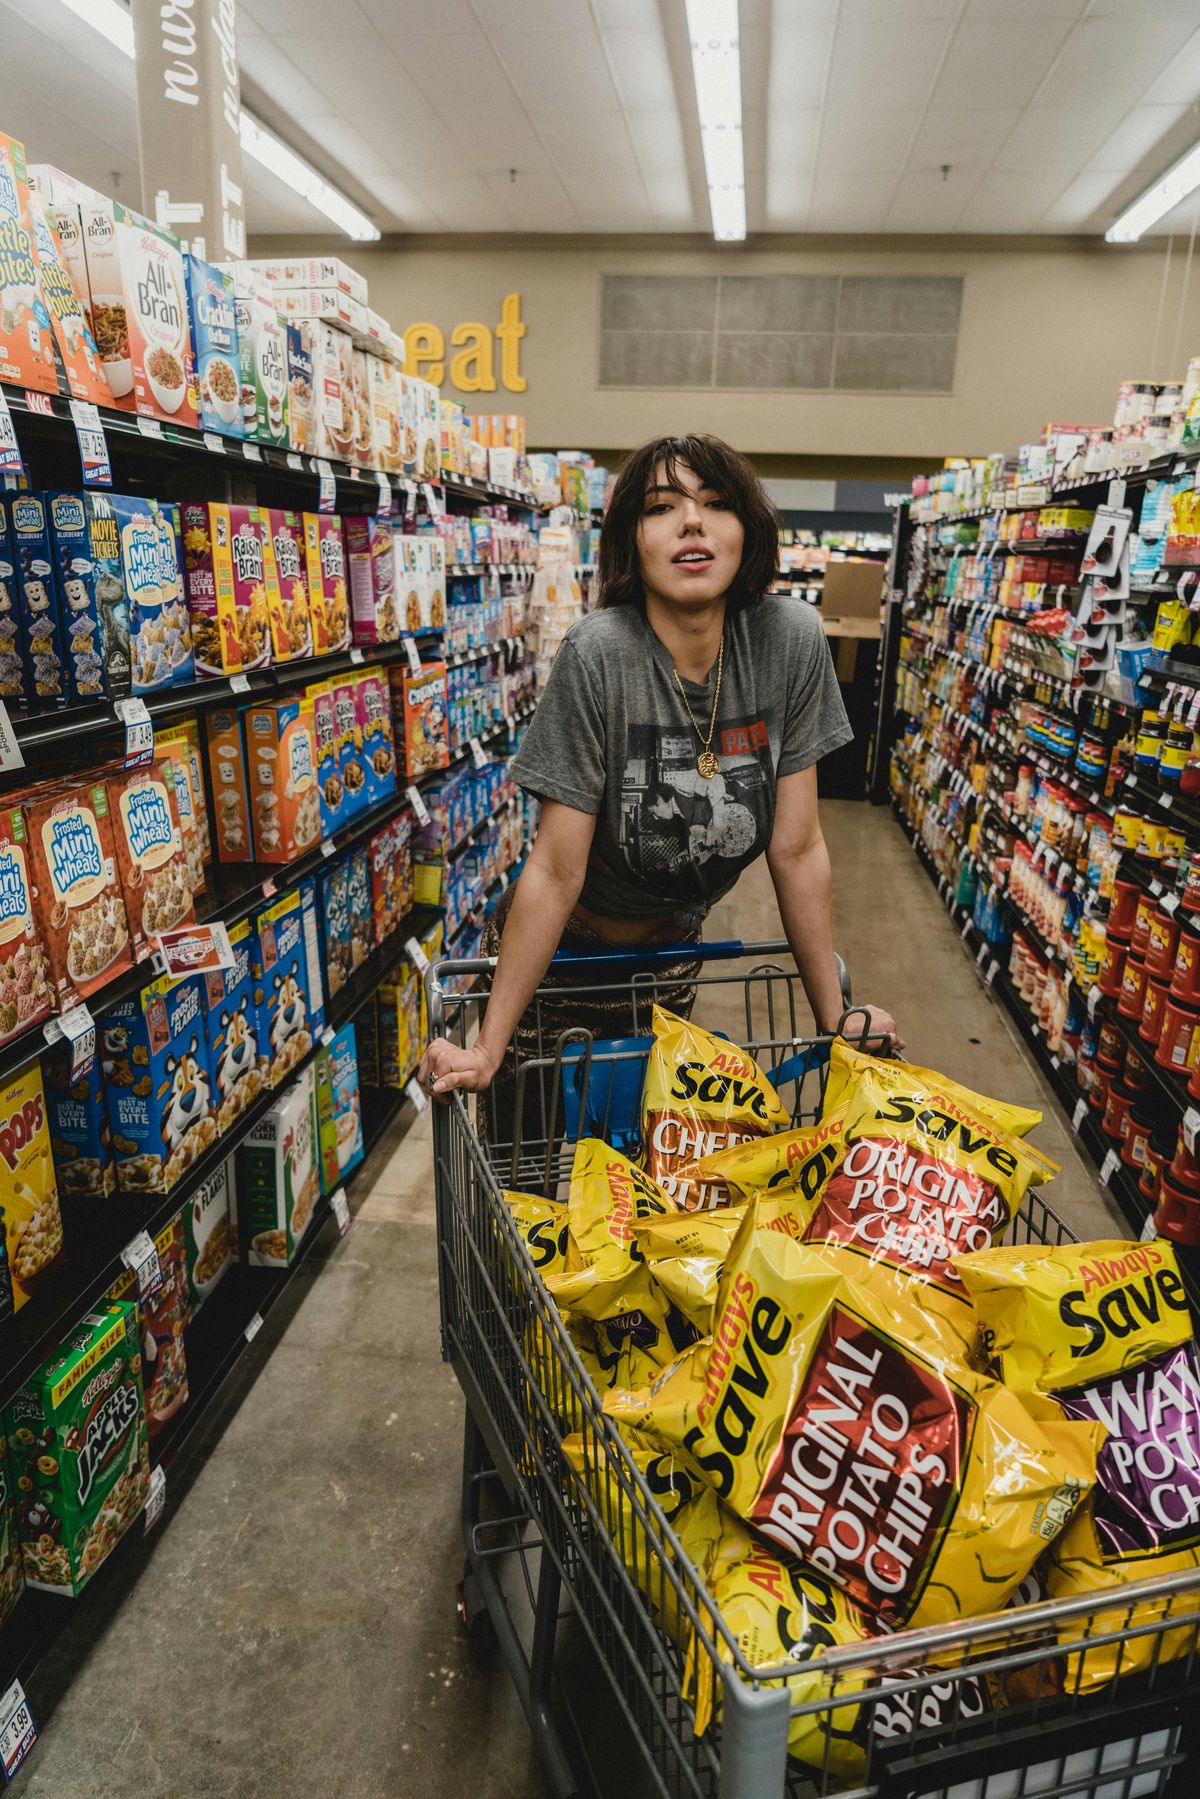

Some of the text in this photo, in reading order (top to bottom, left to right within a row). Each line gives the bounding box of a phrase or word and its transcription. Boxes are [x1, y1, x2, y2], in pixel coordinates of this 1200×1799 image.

[88, 225, 111, 237] Bran
[138, 282, 180, 328] Bran
[402, 293, 527, 393] eat
[262, 354, 282, 378] Bran
[26, 392, 53, 412] WIC
[85, 470, 98, 480] GREAT
[17, 508, 39, 517] Mini
[57, 506, 79, 517] Mini
[93, 496, 111, 518] WIN
[16, 516, 41, 528] Wheats
[56, 515, 82, 526] Wheats
[91, 519, 117, 542] MOVIE
[92, 540, 119, 560] TICKETS
[233, 537, 262, 560] Raisin
[189, 572, 204, 580] BEST
[239, 559, 260, 580] Bran
[190, 579, 213, 587] EVERY
[190, 586, 215, 595] BITE
[125, 756, 140, 768] GREAT
[130, 790, 156, 809] Frosted
[54, 817, 82, 839] Frosted
[129, 800, 166, 834] Mini
[53, 827, 95, 866] Mini
[132, 819, 171, 854] Wheats
[55, 849, 101, 890] Wheats
[171, 986, 199, 1027] FROSTED
[174, 1003, 198, 1037] FLAKES
[335, 1053, 352, 1070] RICE
[671, 1061, 769, 1120] Save
[57, 1103, 75, 1111] BEST
[58, 1109, 85, 1118] EVERY
[120, 1106, 147, 1114] EVERY
[59, 1117, 89, 1128] BITE
[120, 1113, 150, 1125] BITE
[0, 1091, 44, 1173] POPS
[875, 1096, 1019, 1178] Save
[201, 1175, 226, 1211] FLAKES
[605, 1162, 636, 1241] Always
[849, 1179, 993, 1250] POTATO
[675, 1233, 691, 1245] BEST
[1079, 1246, 1163, 1292] Always
[1060, 1268, 1190, 1359] Save
[697, 1271, 756, 1425] Always
[58, 1325, 122, 1398] FAMILY SIZE
[684, 1296, 793, 1500] Save
[87, 1386, 125, 1443] APPLE
[78, 1386, 139, 1506] JACKS
[809, 1393, 910, 1586] POTATO
[863, 1444, 947, 1594] CHIPS
[1042, 1520, 1055, 1537] 150
[11, 1708, 29, 1739] 3.99
[8, 1747, 23, 1777] GREAT
